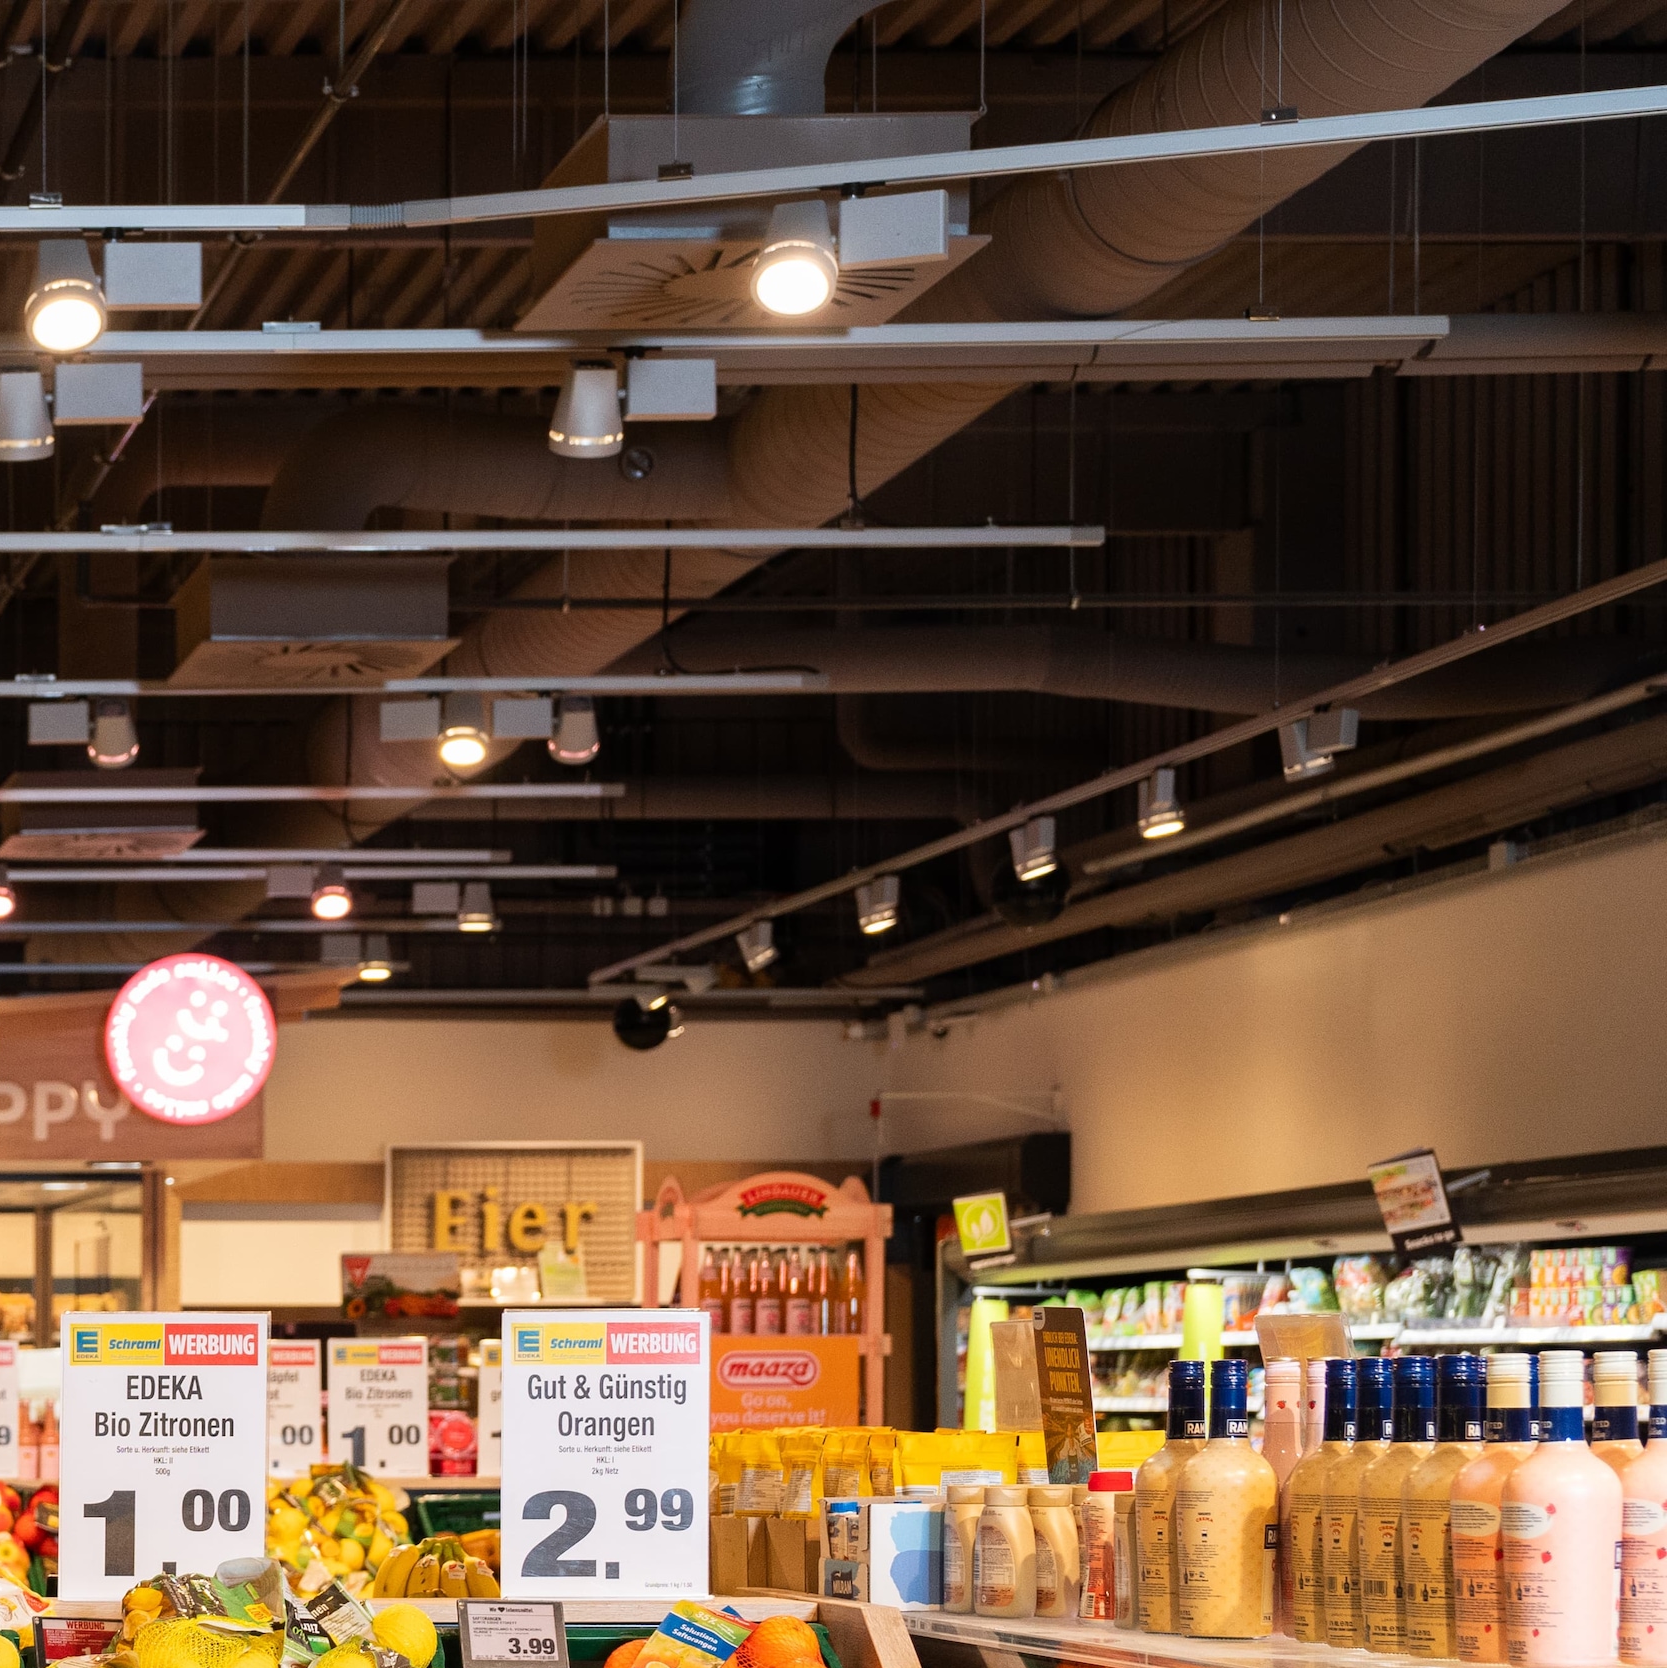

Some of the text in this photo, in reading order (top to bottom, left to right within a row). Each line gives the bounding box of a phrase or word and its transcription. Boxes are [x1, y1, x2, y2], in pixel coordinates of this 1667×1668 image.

[434, 1187, 597, 1255] Eier
[109, 1334, 255, 1355] Schraml WERBUNG
[550, 1333, 696, 1354] Schraml WERBUNG
[1045, 1346, 1080, 1369] UNENDLICH
[360, 1370, 396, 1381] EDEKA
[726, 1358, 811, 1378] maaza
[127, 1375, 202, 1400] EDEKA
[528, 1374, 687, 1404] Gut & Günstig
[1049, 1371, 1082, 1393] PUNKTEN.
[346, 1387, 412, 1400] Bio Zitronen
[741, 1393, 763, 1407] Go
[95, 1412, 234, 1436] Bio Zitronen
[558, 1411, 655, 1441] Orangen
[711, 1410, 826, 1427] you deserve it!
[142, 1445, 170, 1454] Herkunft:
[559, 1445, 575, 1453] Sorte
[584, 1445, 612, 1453] Herkunft:
[614, 1445, 630, 1453] siehe
[632, 1445, 652, 1453] Etikett
[156, 1468, 170, 1476] 500g
[592, 1467, 619, 1476] 2kg Netz
[66, 1620, 106, 1630] WERBUNG
[679, 1623, 718, 1644] Salustiana
[508, 1637, 555, 1655] 3.99
[672, 1627, 717, 1652] Saftorangen
